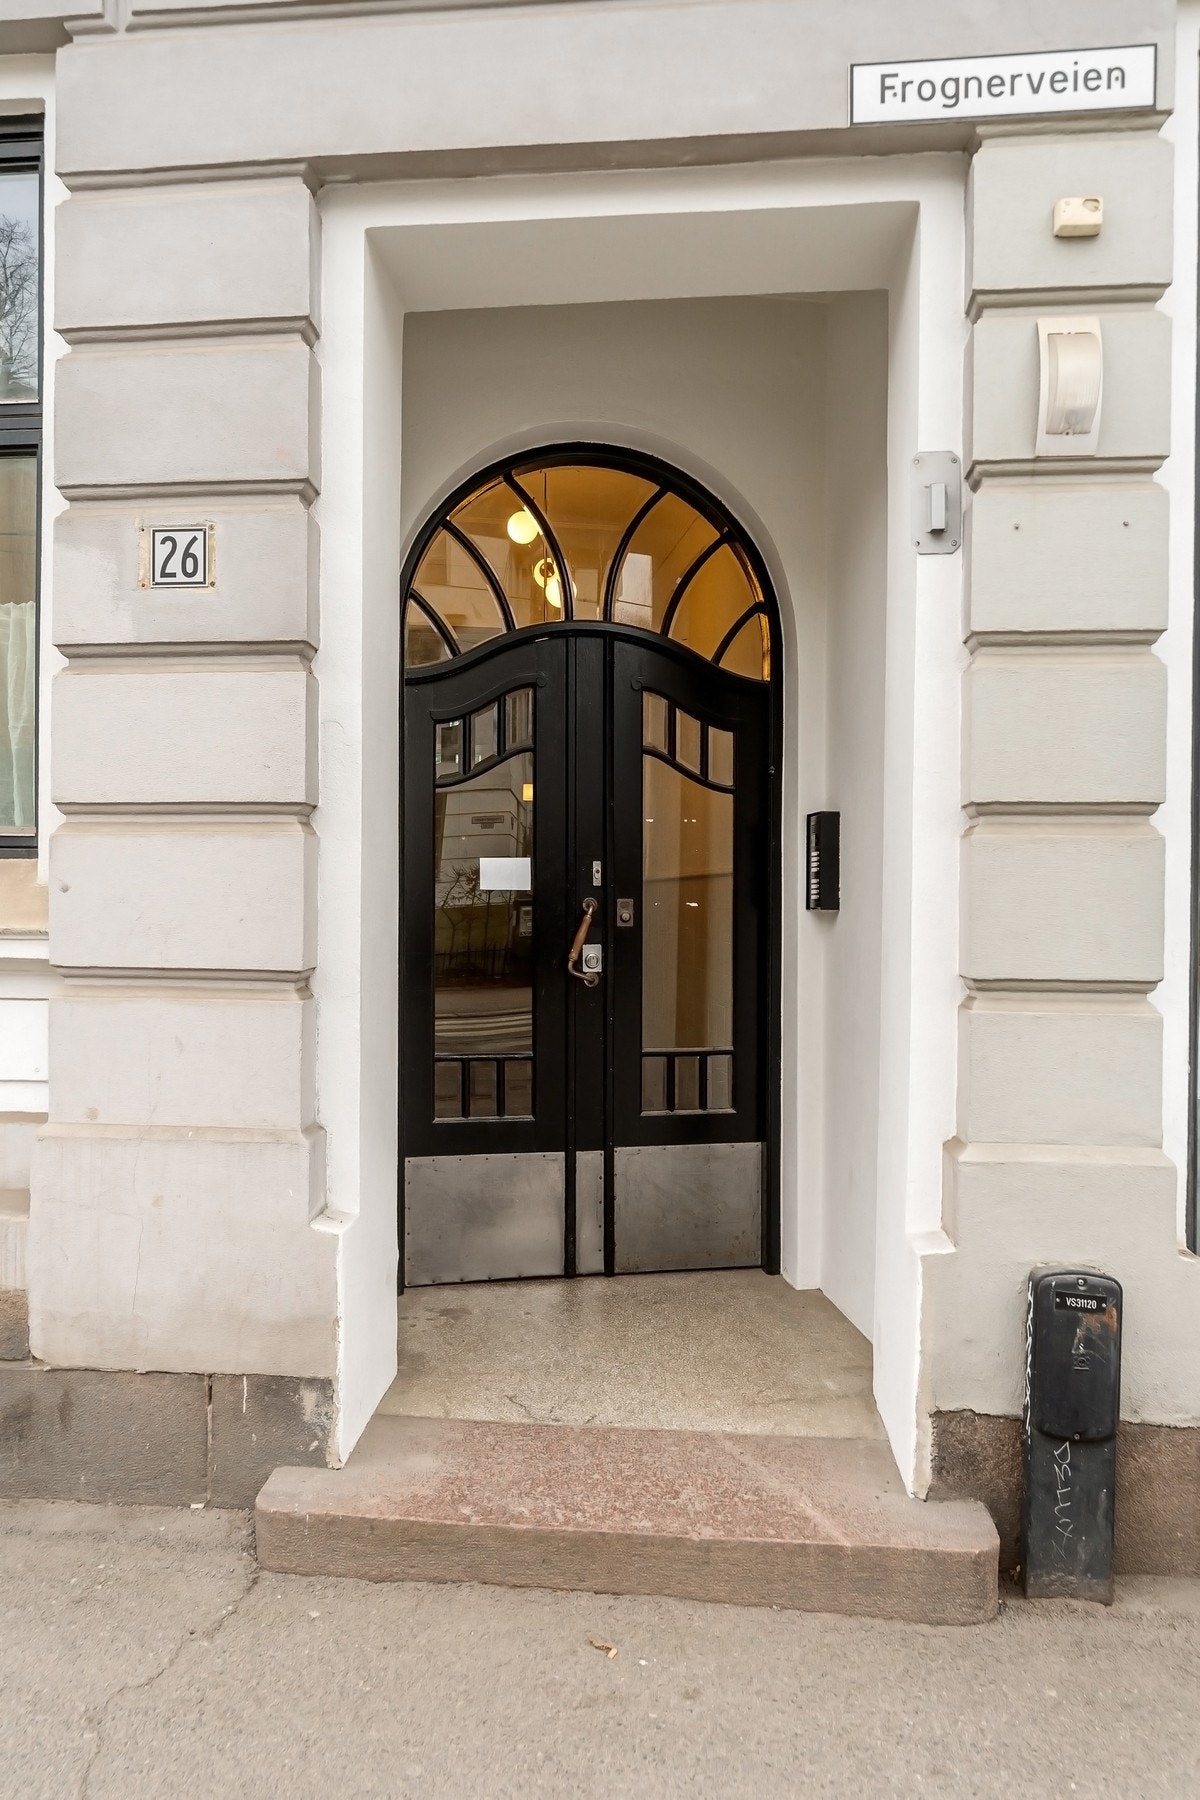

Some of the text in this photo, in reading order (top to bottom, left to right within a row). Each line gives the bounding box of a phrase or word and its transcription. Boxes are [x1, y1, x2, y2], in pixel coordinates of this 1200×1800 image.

[879, 60, 1126, 109] Frognerveien
[159, 535, 199, 579] 26
[1065, 1296, 1098, 1310] VS31120
